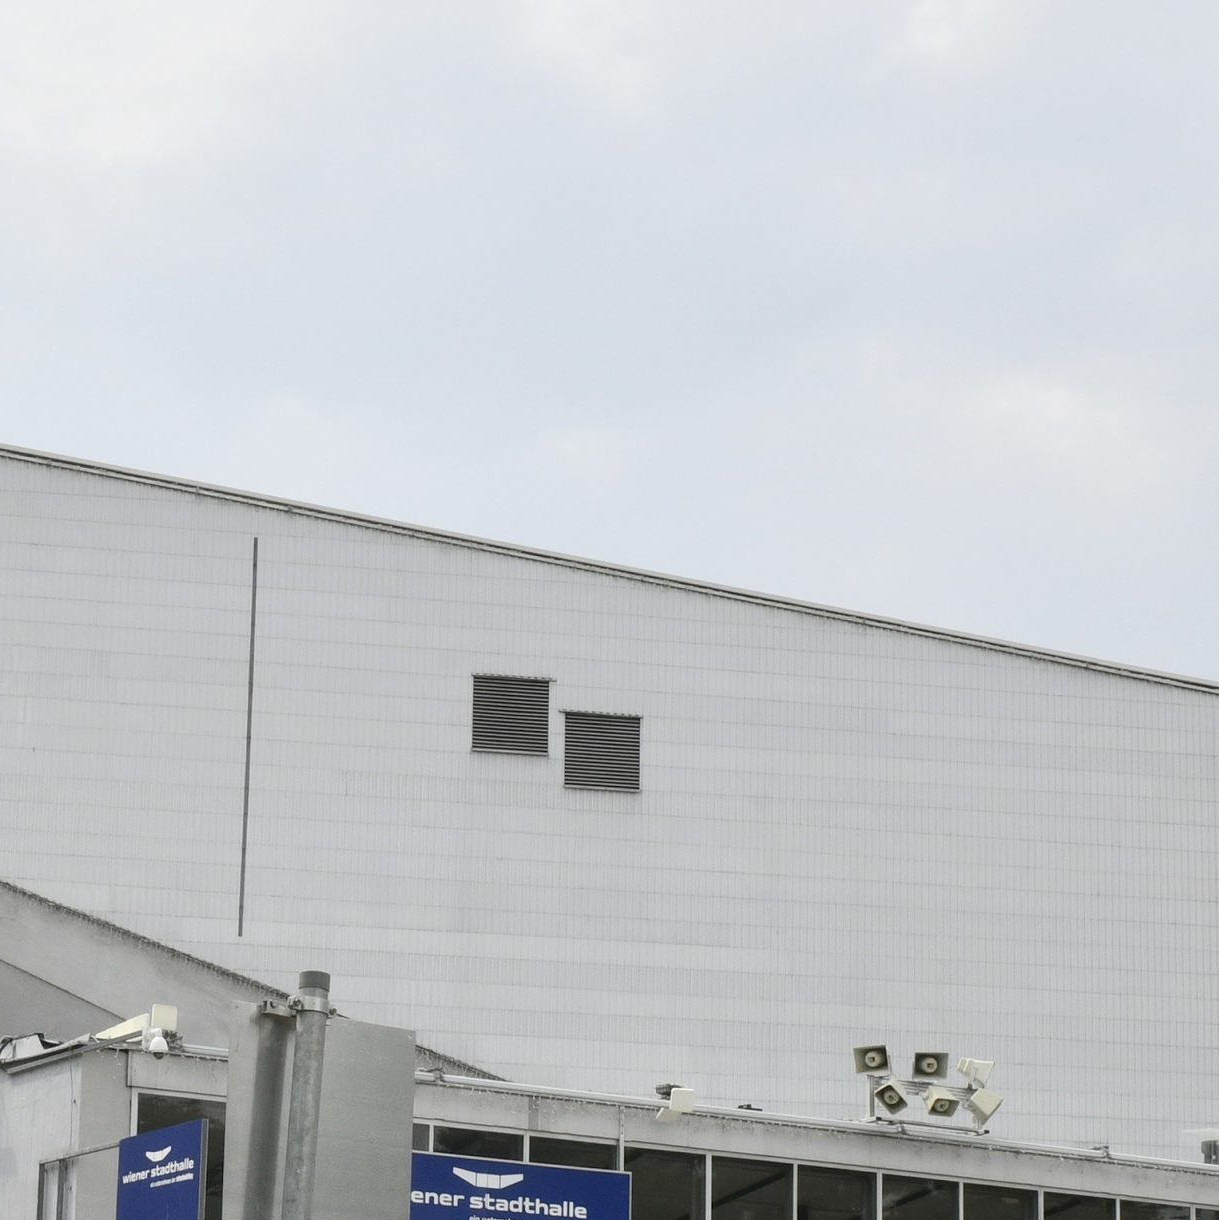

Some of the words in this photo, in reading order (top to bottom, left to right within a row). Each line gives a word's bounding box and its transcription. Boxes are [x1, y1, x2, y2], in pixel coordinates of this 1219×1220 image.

[122, 1169, 150, 1185] wiener
[150, 1158, 195, 1178] stadthalle
[410, 1190, 465, 1207] ener
[469, 1193, 588, 1219] stadthalle
